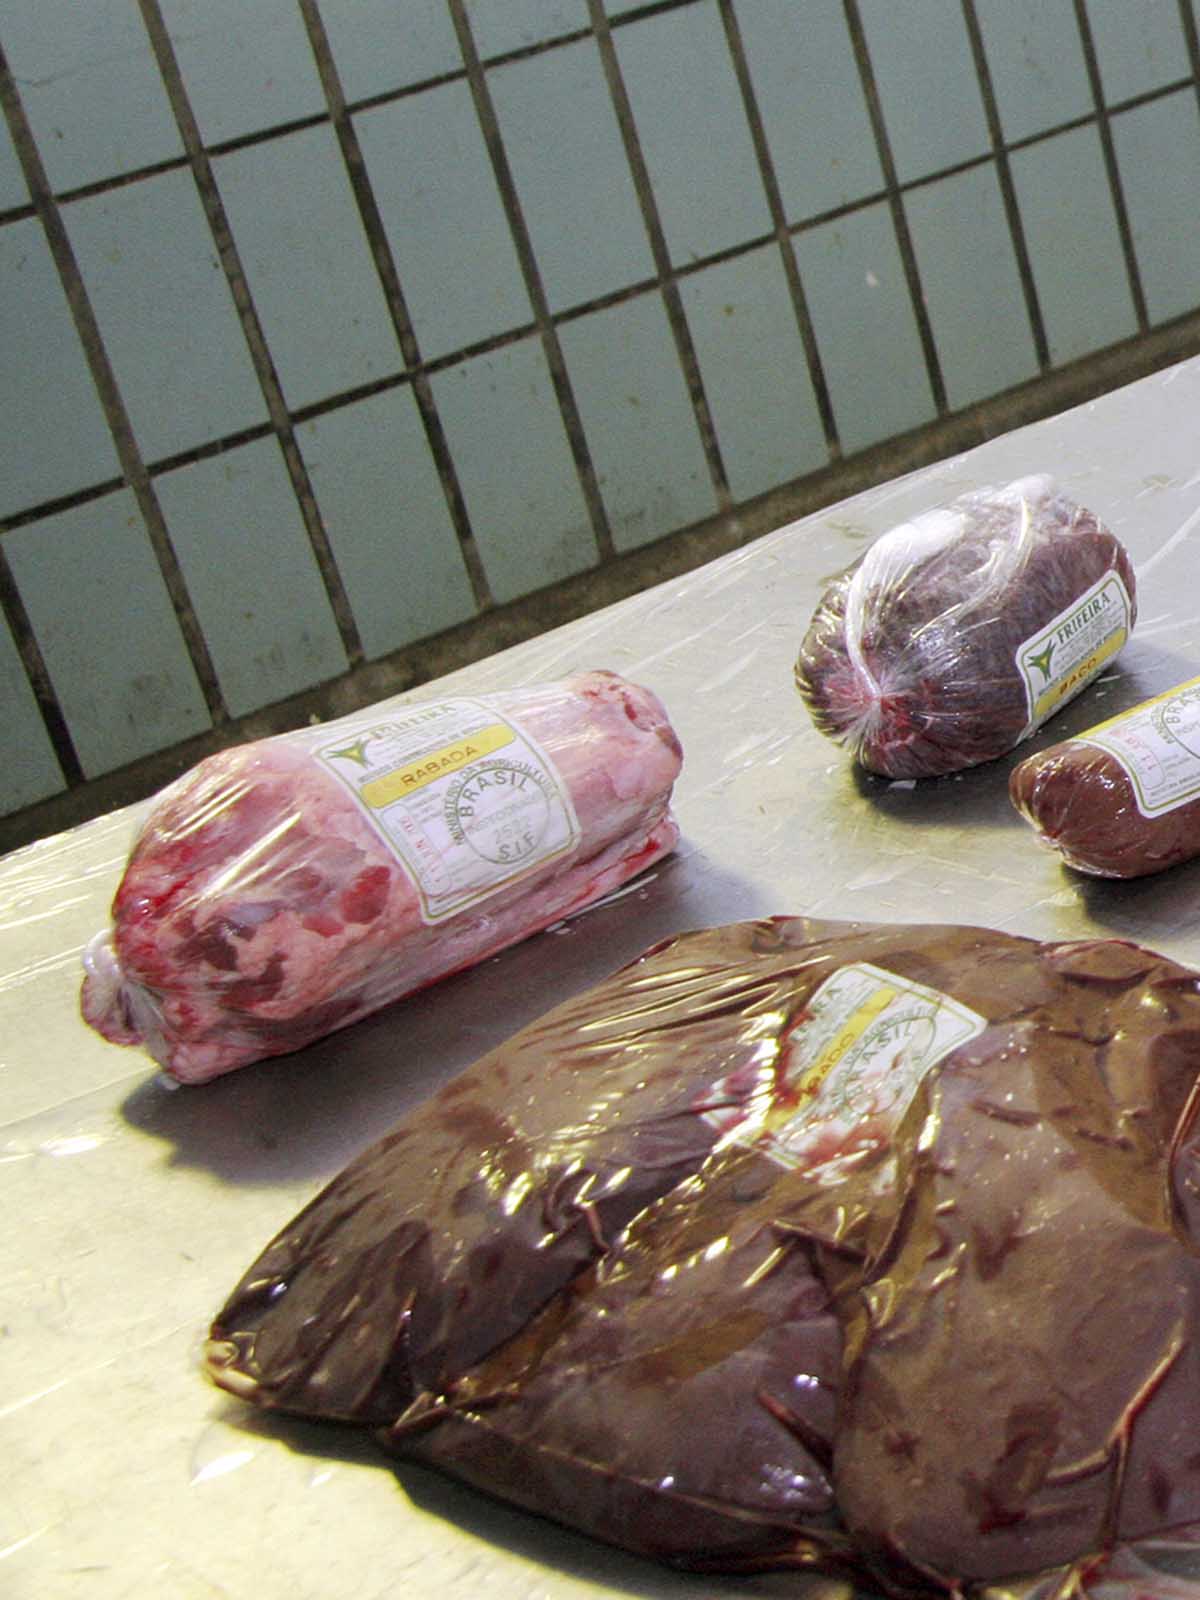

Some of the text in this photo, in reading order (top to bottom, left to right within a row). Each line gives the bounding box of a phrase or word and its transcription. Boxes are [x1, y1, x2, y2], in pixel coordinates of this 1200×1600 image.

[1056, 591, 1112, 645] FRIFEIRA
[401, 745, 479, 787] RABADA
[459, 770, 527, 818] BRASIL
